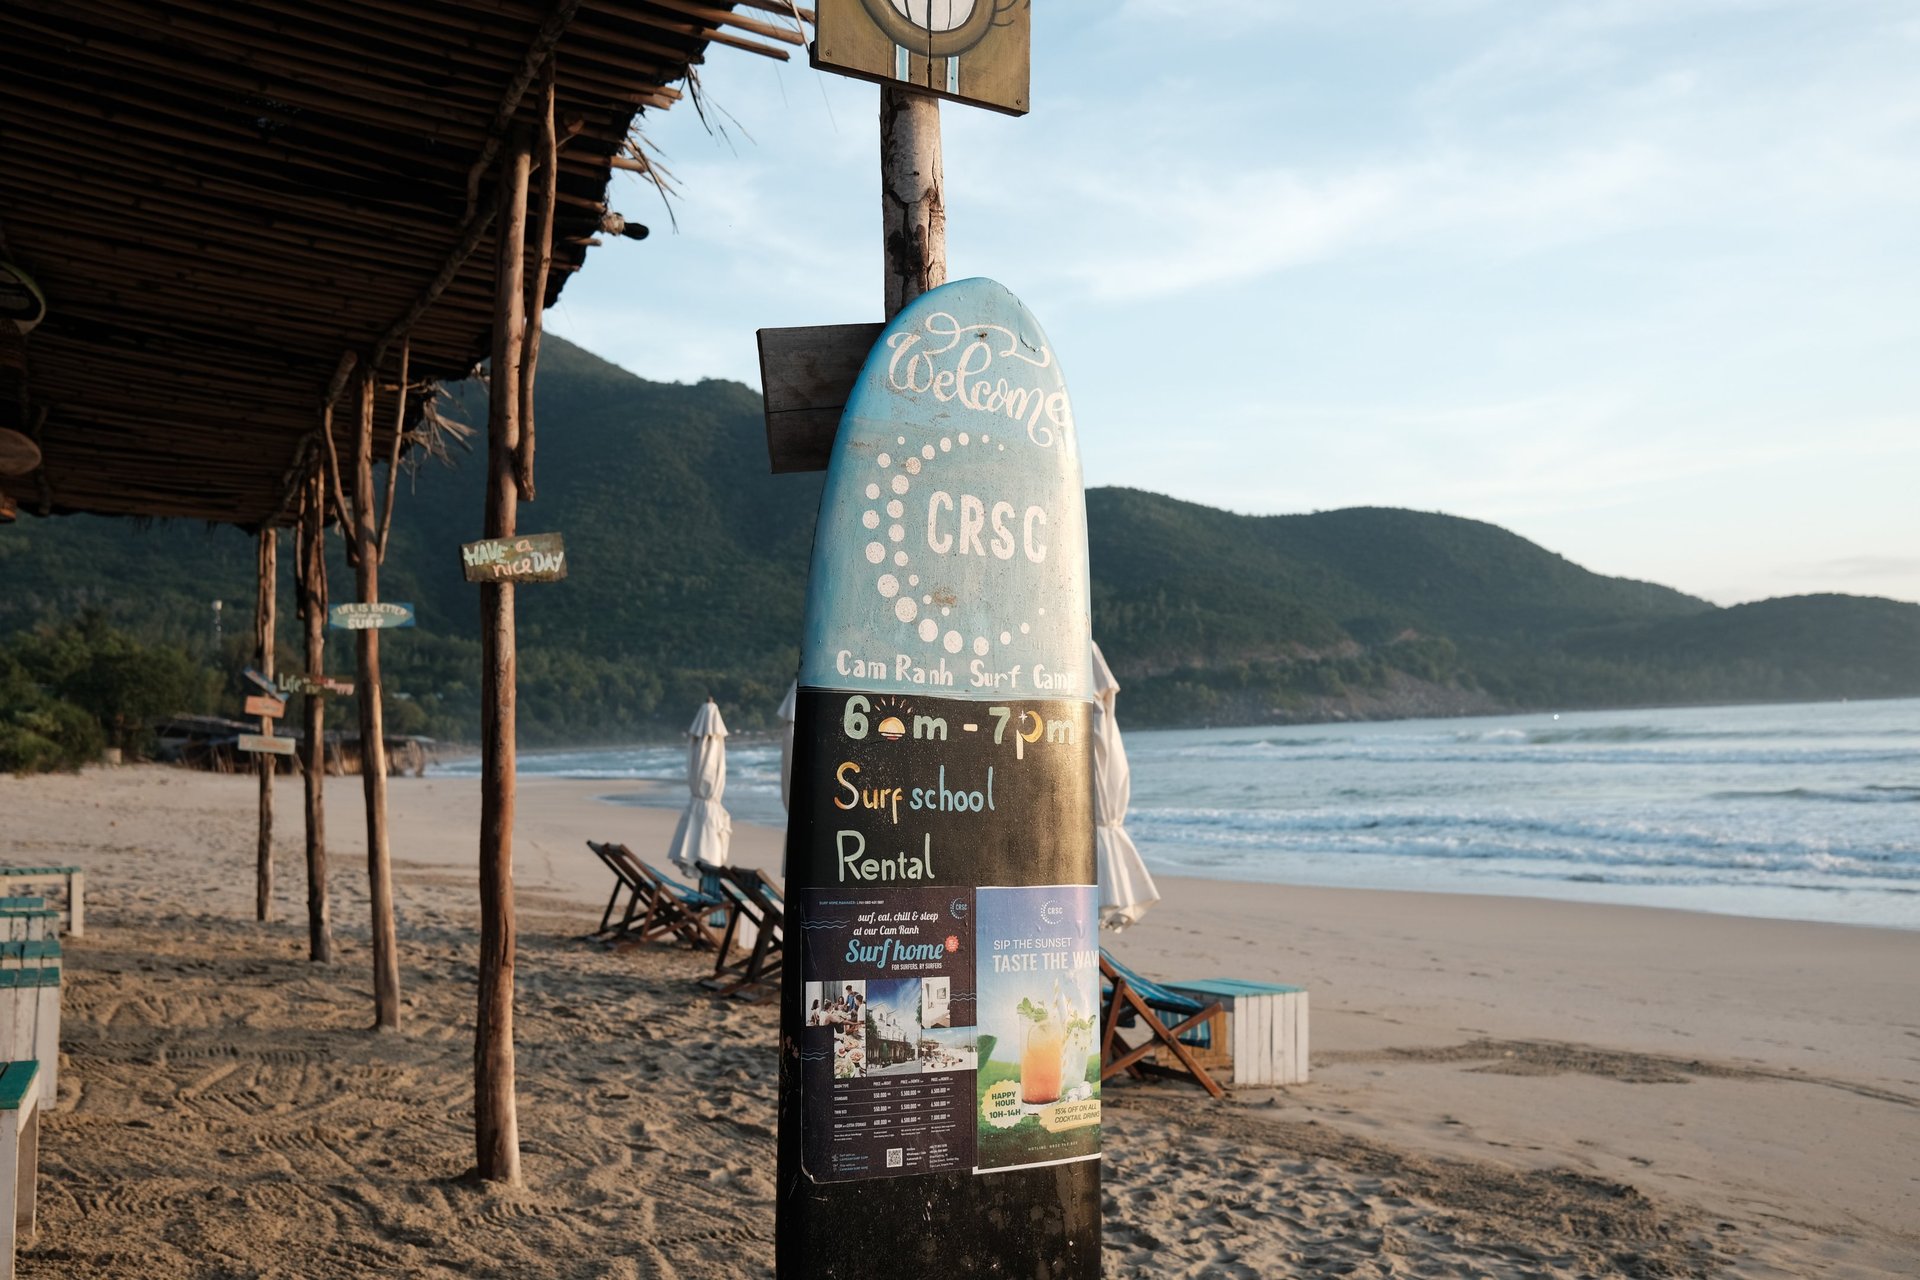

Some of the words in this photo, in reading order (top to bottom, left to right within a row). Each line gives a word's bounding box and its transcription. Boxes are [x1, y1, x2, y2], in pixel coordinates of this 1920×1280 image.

[886, 312, 1068, 448] Welcome
[927, 490, 1047, 564] CRSC
[463, 541, 508, 567] HAVE
[515, 539, 534, 553] a
[493, 558, 533, 577] nice
[530, 551, 565, 573] DAY
[836, 650, 887, 680] Cam
[895, 654, 954, 686] Ranh
[970, 659, 1021, 688] Surf
[988, 706, 1076, 760] 7pm
[834, 761, 904, 825] Surf
[909, 764, 996, 812] school
[836, 829, 936, 882] Rental
[857, 912, 876, 925] surf,
[878, 913, 893, 923] eat,
[894, 912, 911, 922] chill
[912, 911, 919, 921] &
[920, 911, 939, 924] sleep
[1047, 907, 1063, 915] CRSC
[853, 926, 863, 936] at
[880, 925, 897, 935] Cam
[898, 925, 920, 935] Ranh
[993, 939, 1011, 951] SIP
[1013, 938, 1033, 950] THE
[1034, 937, 1073, 949] SUNSET
[845, 938, 893, 969] Surf
[893, 939, 945, 961] home
[992, 952, 1038, 973] TASTE
[1042, 951, 1069, 970] THE
[892, 963, 900, 971] FOR
[925, 962, 943, 970] SURFERS
[991, 1091, 1017, 1101] HAPPY
[995, 1099, 1016, 1108] HOUR
[989, 1108, 1021, 1119] 10H-14H
[1054, 1113, 1082, 1123] COCKTAIL
[1055, 1107, 1067, 1115] 15%
[1067, 1105, 1079, 1114] OFF
[1079, 1104, 1088, 1112] ON
[1088, 1103, 1097, 1111] ALL
